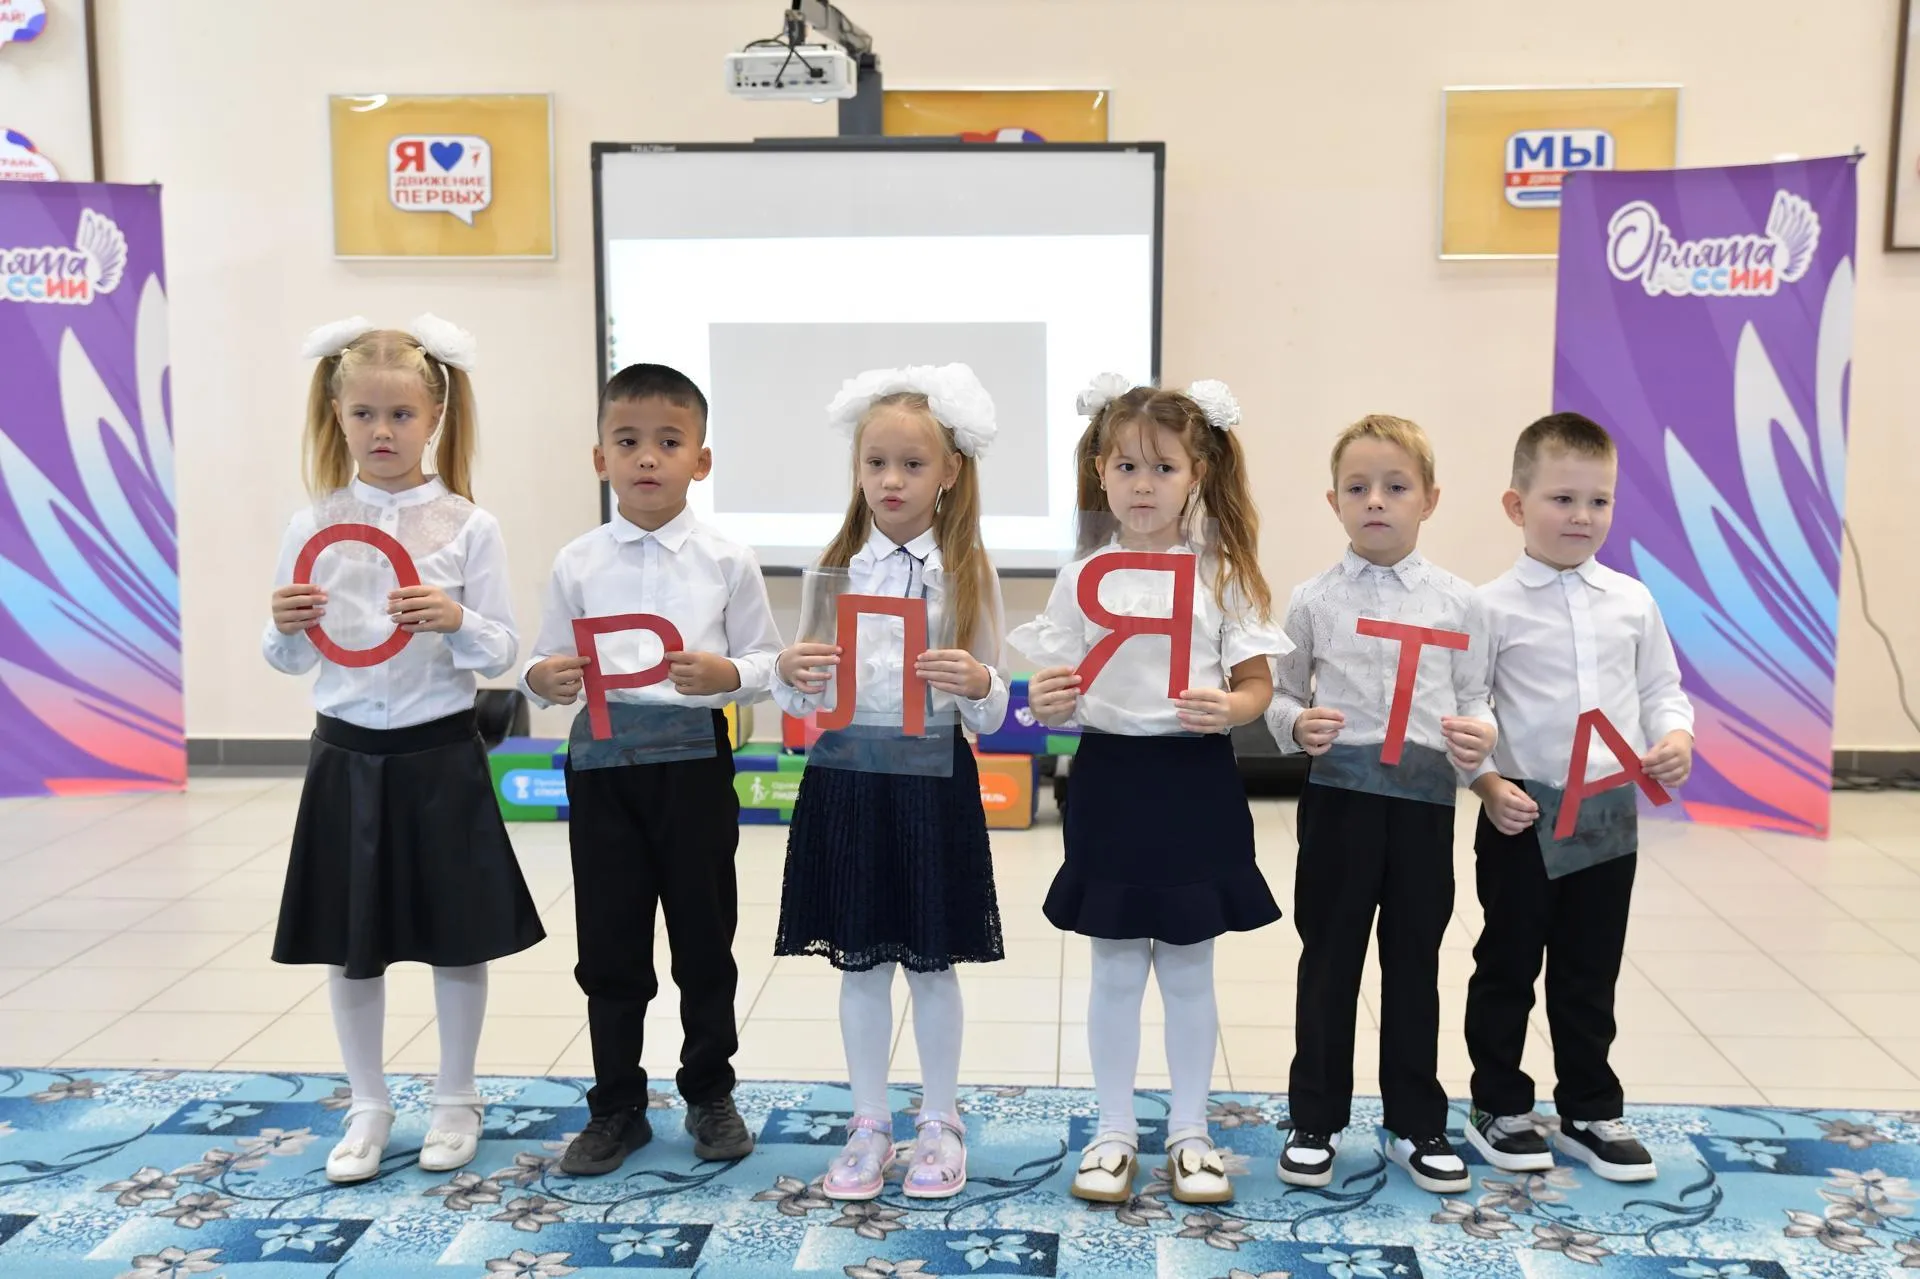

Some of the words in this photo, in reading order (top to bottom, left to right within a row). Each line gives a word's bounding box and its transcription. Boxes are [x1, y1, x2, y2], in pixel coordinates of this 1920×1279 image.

[395, 141, 425, 172] Я
[395, 176, 485, 187] ДВИЖЕНИЕ
[395, 189, 485, 204] ПЕРВЫХ
[1514, 135, 1605, 169] МЫ
[0, 252, 87, 279] ята
[1613, 206, 1777, 281] Орлята
[293, 523, 421, 667] О
[1076, 551, 1196, 699] Я
[572, 613, 684, 740] Р
[816, 594, 926, 736] Л
[1356, 617, 1469, 766] Т
[1553, 707, 1672, 841] А
